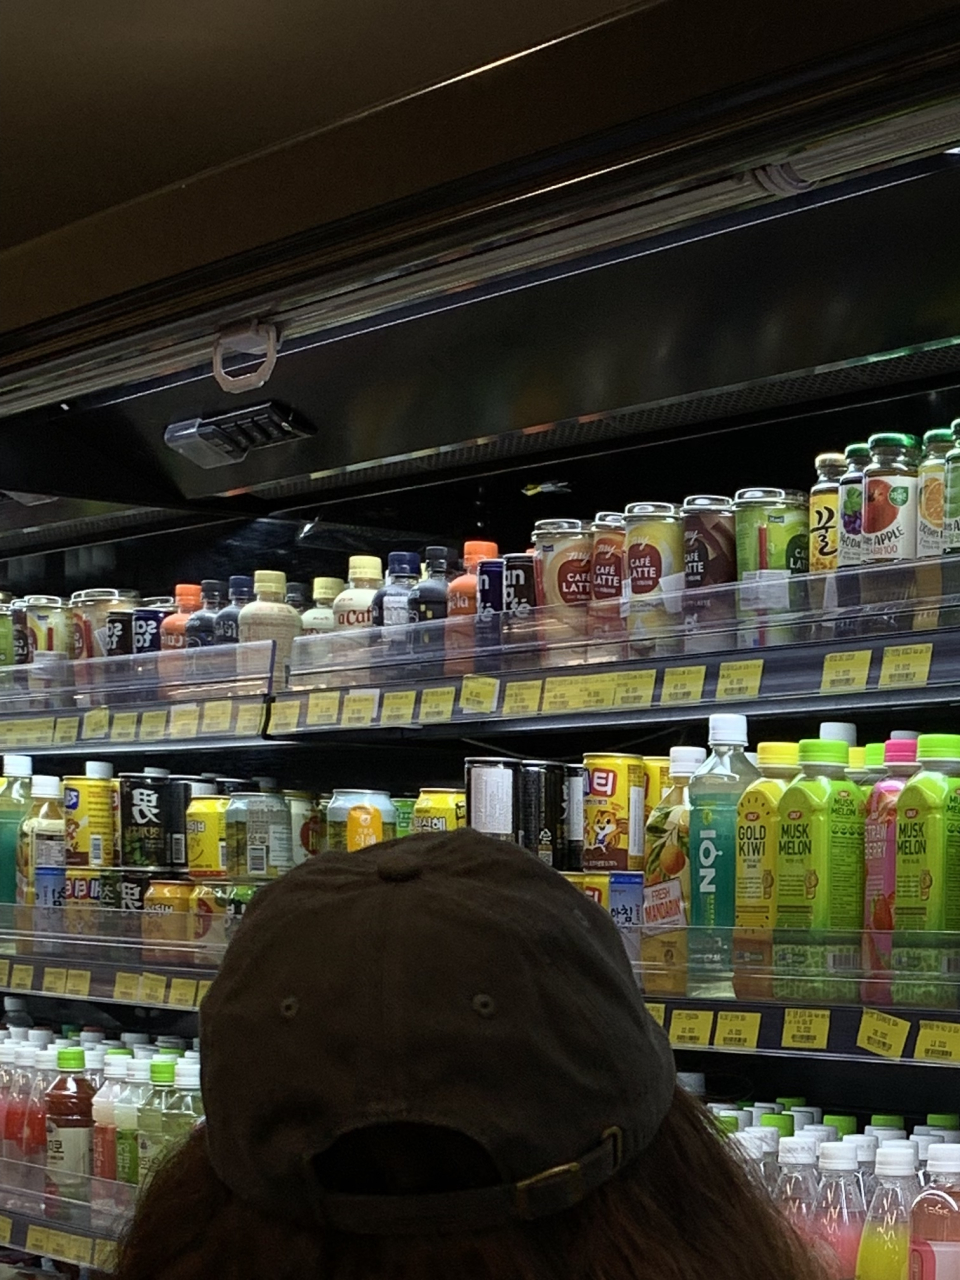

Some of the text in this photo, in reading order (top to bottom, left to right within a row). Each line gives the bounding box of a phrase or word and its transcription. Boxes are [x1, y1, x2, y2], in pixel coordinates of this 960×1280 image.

[810, 506, 837, 556] 꿀
[874, 525, 905, 546] APPLE
[685, 562, 704, 573] ATTE
[562, 582, 590, 592] LATT
[833, 798, 855, 808] MUSK
[831, 807, 857, 817] MELON
[738, 825, 766, 841] GOLD
[781, 823, 809, 839] MUSK
[899, 823, 924, 838] MUSK
[738, 841, 766, 856] KIWI
[778, 840, 812, 856] MELON
[897, 840, 926, 856] MELON
[652, 887, 670, 900] FRESH
[644, 898, 682, 923] MANDARIN
